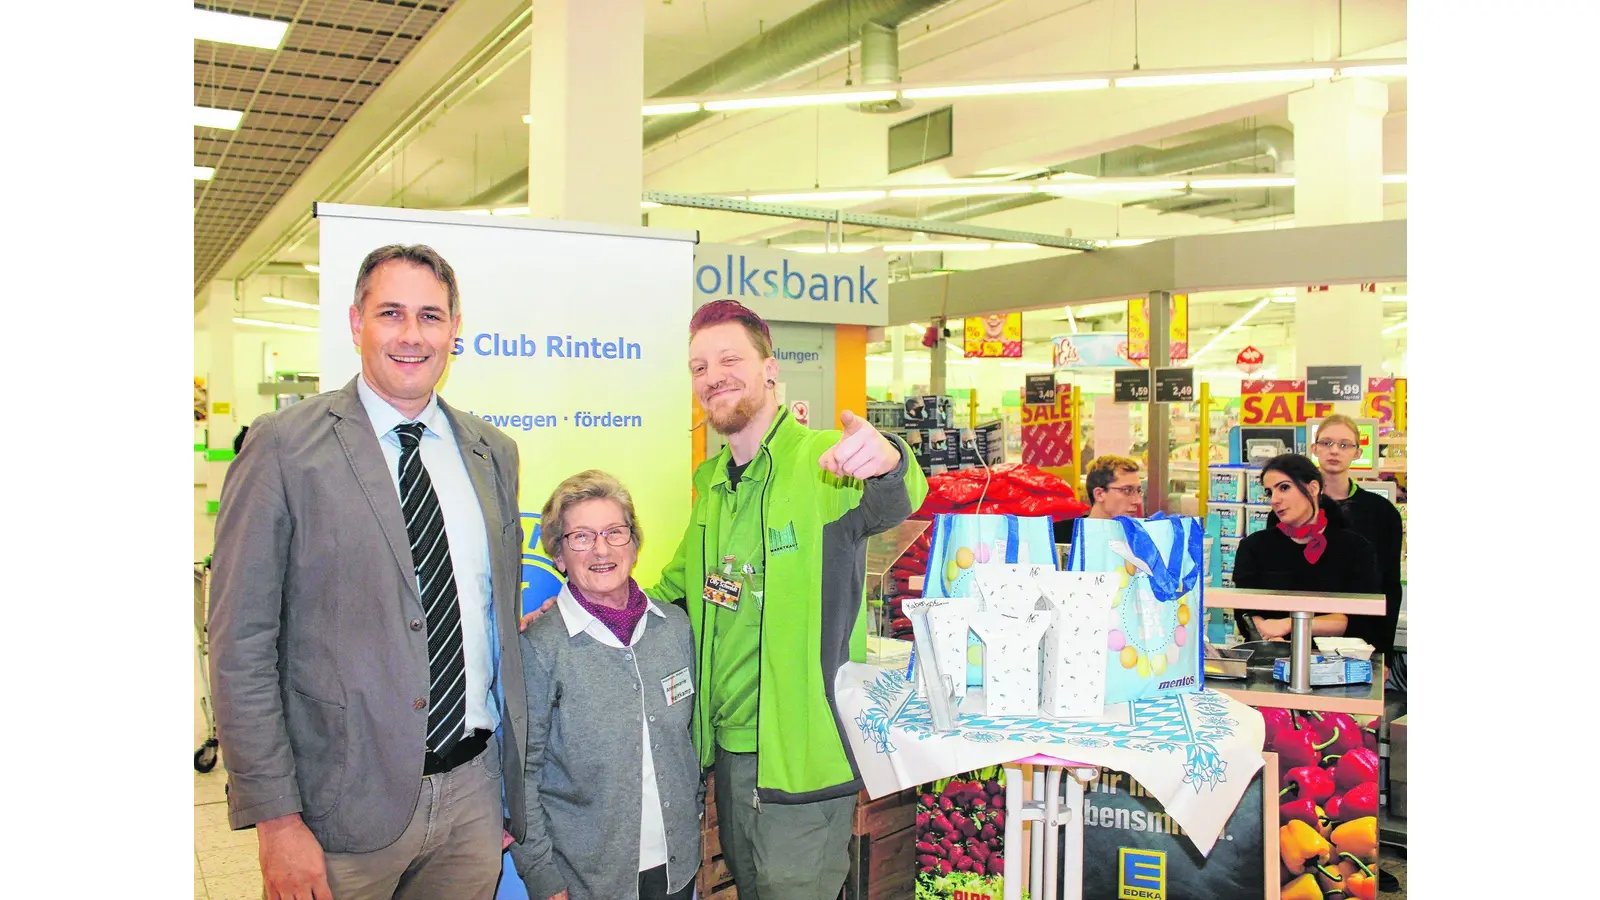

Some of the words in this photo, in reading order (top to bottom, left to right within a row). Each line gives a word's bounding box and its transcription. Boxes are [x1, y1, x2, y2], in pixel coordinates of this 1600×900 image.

[693, 254, 879, 305] olksbank
[473, 333, 537, 358] Club
[546, 336, 642, 360] Rinteln
[1131, 386, 1149, 397] 1,59
[1172, 385, 1193, 397] 2,49
[1332, 384, 1360, 397] 5,99
[1022, 394, 1071, 423] SALE
[470, 410, 557, 431] ewegen
[574, 409, 642, 427] fördern
[1158, 675, 1195, 690] mentos
[1124, 853, 1161, 890] E
[1124, 888, 1162, 900] EDEKA
